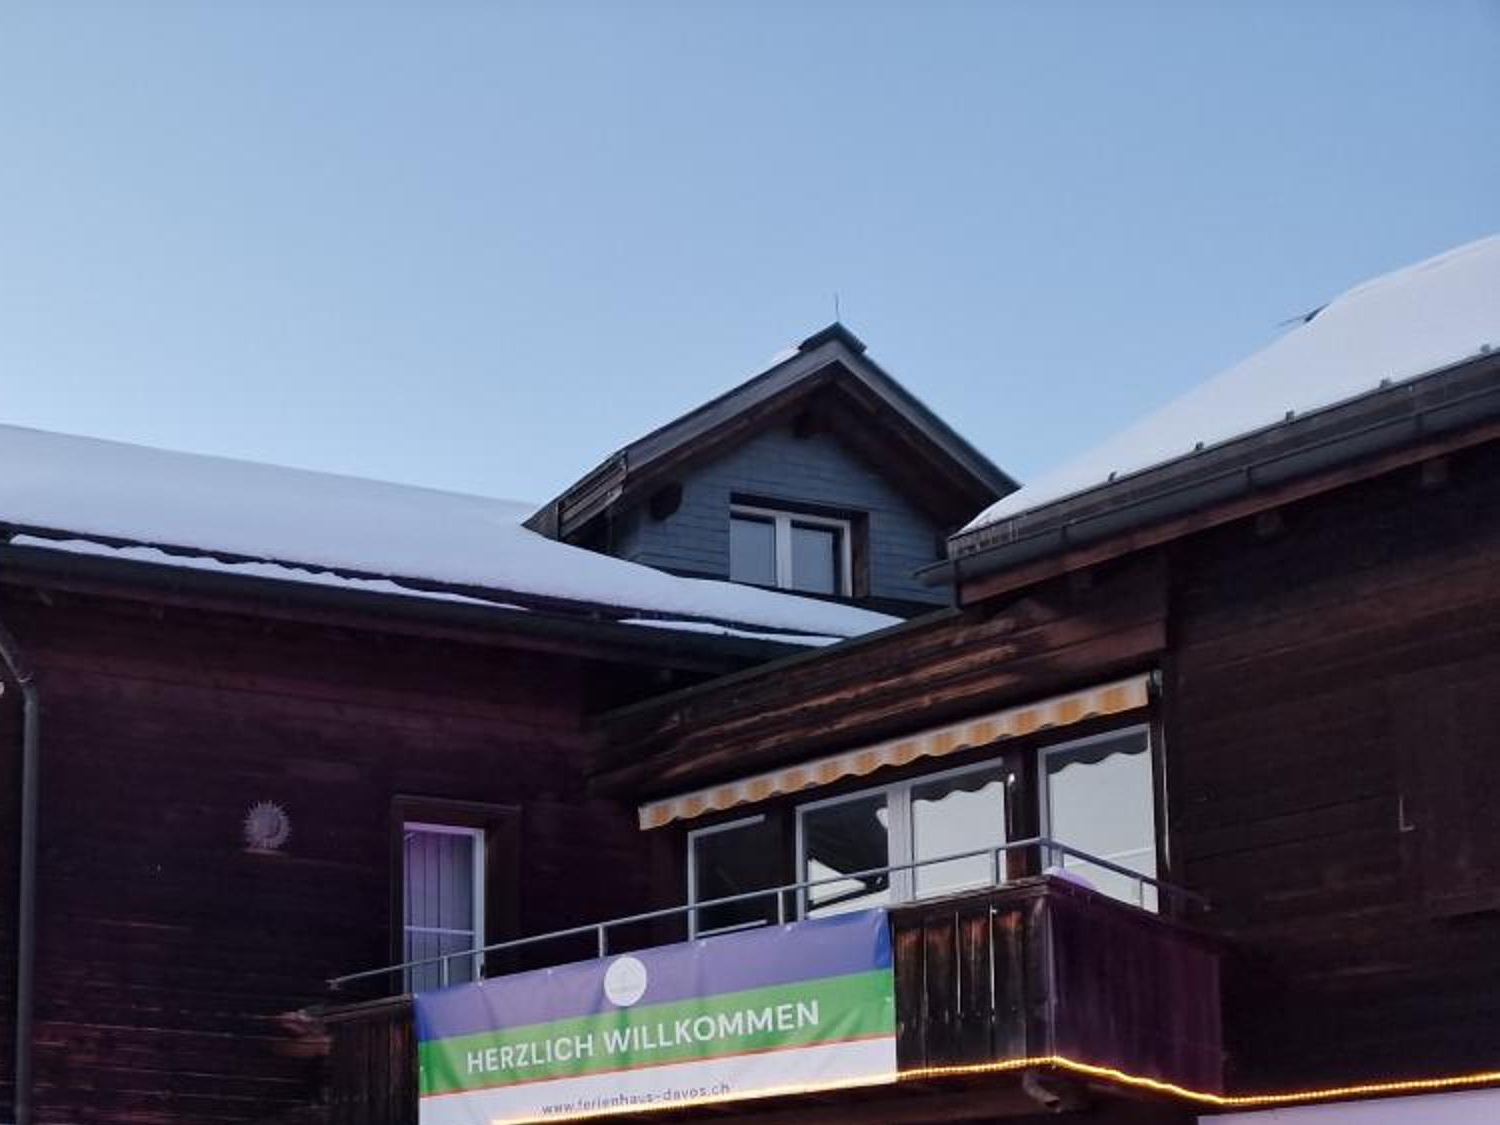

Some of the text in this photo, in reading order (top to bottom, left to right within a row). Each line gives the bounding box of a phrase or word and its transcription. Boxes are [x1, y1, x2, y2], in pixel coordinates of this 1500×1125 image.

[467, 1001, 820, 1073] HERZLICH WILLKOMMEN
[542, 1084, 731, 1115] www.ferienhaus-davos.ch
